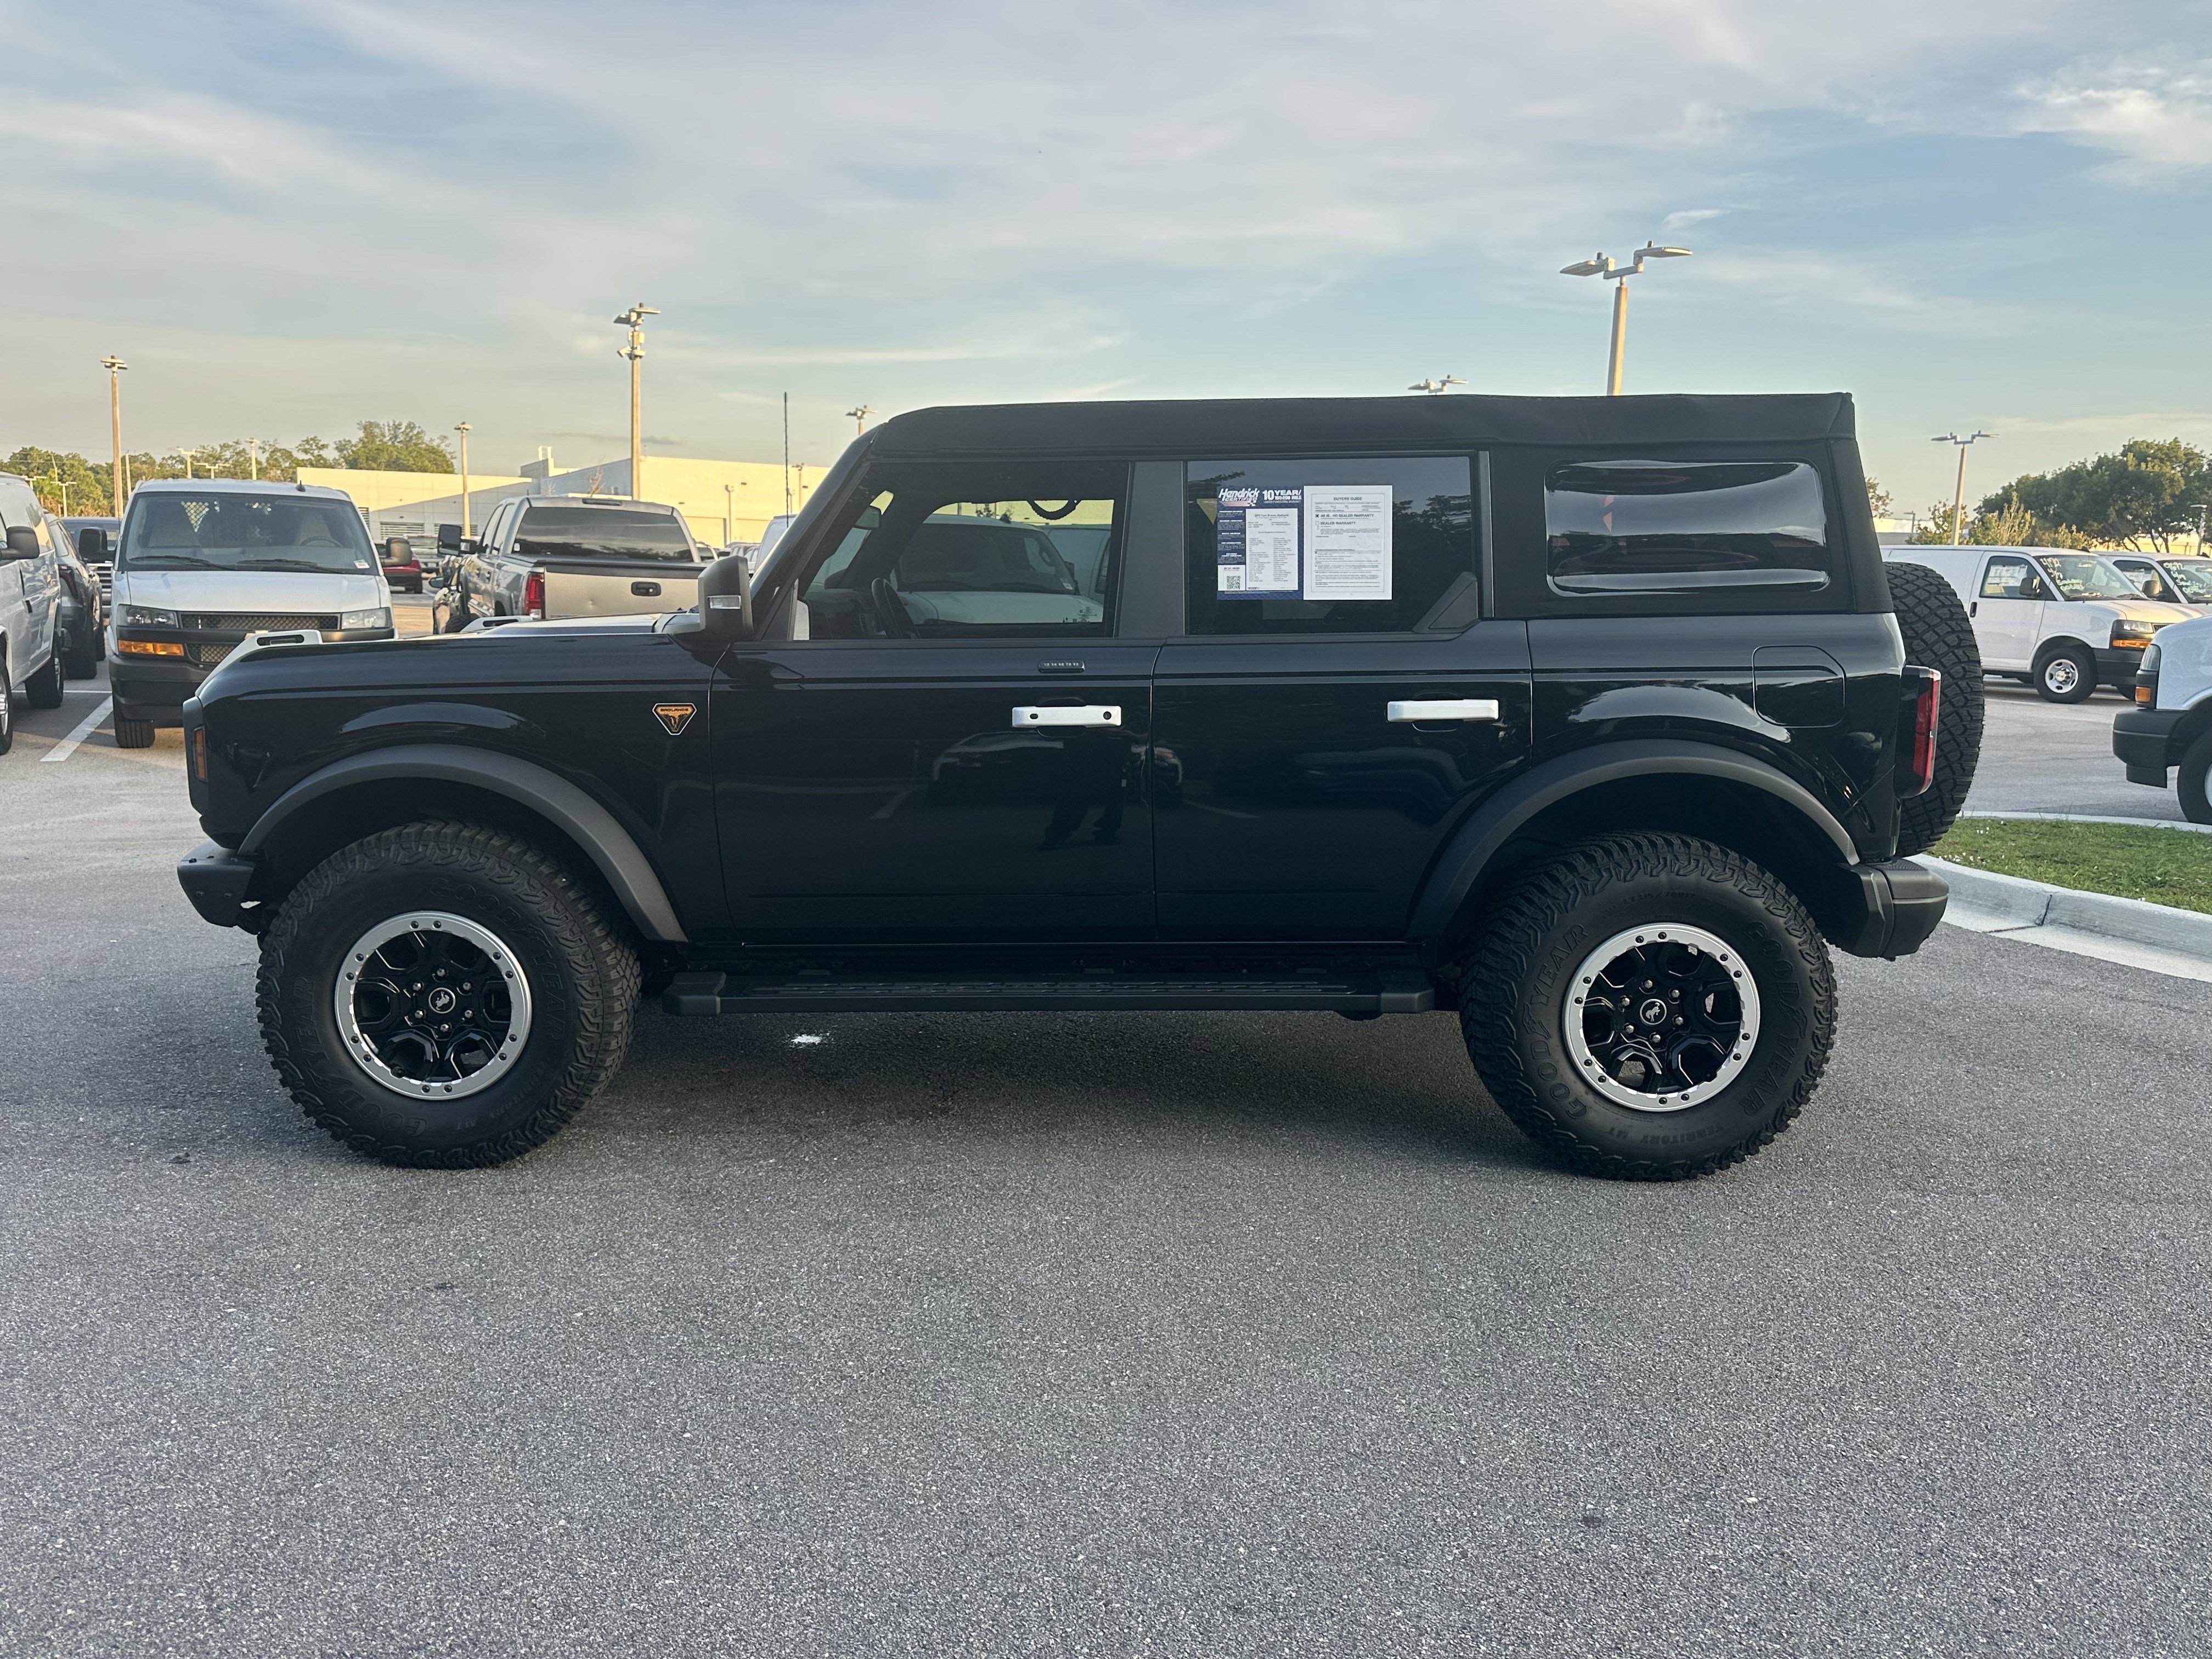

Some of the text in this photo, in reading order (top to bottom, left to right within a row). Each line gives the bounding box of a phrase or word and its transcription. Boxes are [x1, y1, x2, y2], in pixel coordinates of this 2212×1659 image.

[1218, 488, 1260, 501] Hendrick
[1262, 489, 1274, 500] 10
[292, 977, 427, 1138] GOODYEAR
[1522, 923, 1589, 1120] GOODYEAR
[1738, 921, 1808, 1116] GOODYEAR
